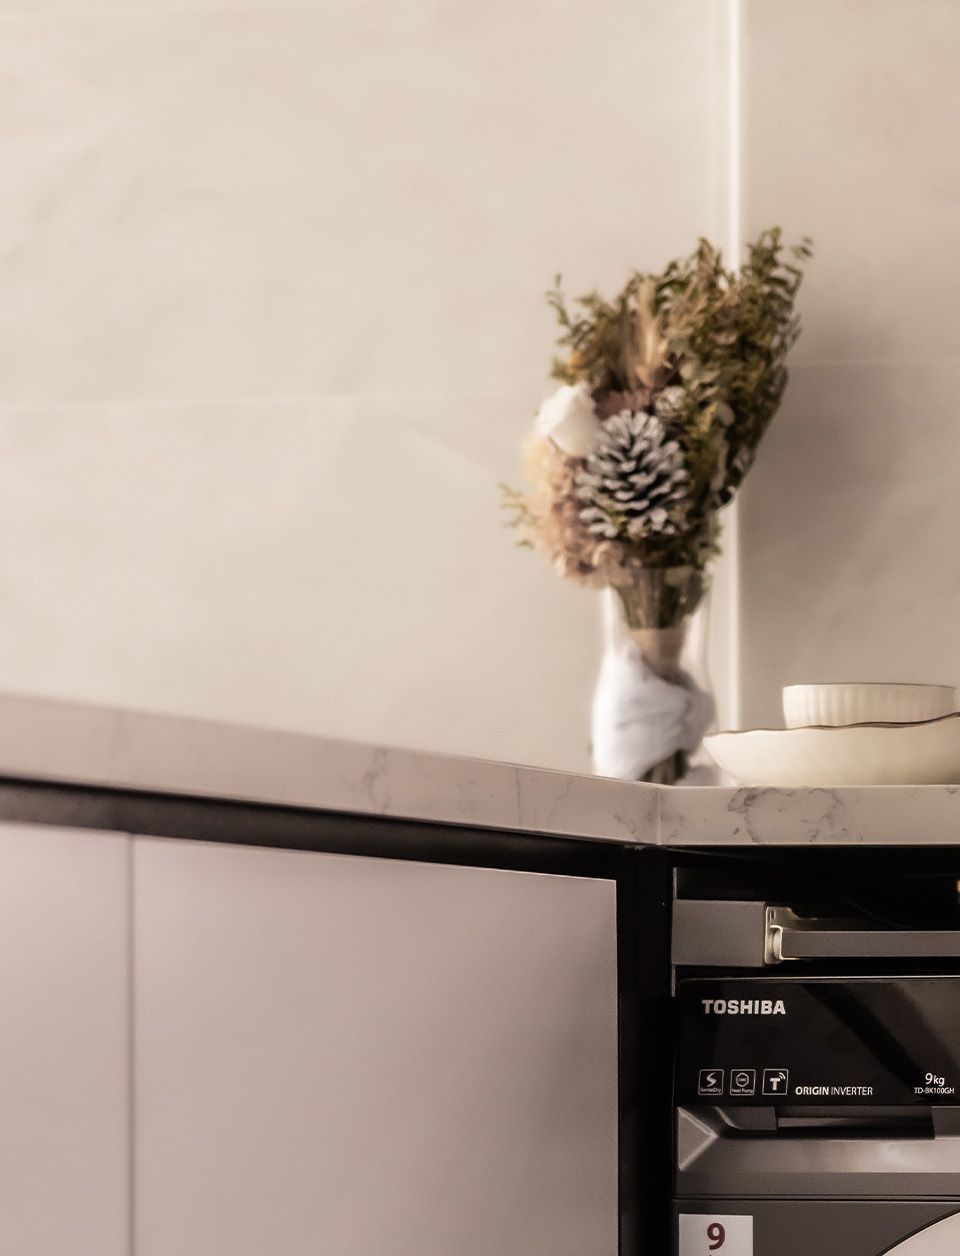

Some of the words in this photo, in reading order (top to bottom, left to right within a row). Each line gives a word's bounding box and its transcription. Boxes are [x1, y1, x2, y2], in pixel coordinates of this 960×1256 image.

[702, 1000, 786, 1015] TOSHIBA
[795, 1086, 829, 1096] ORIGIN
[831, 1086, 873, 1096] INVERTER
[707, 1222, 725, 1250] 9
